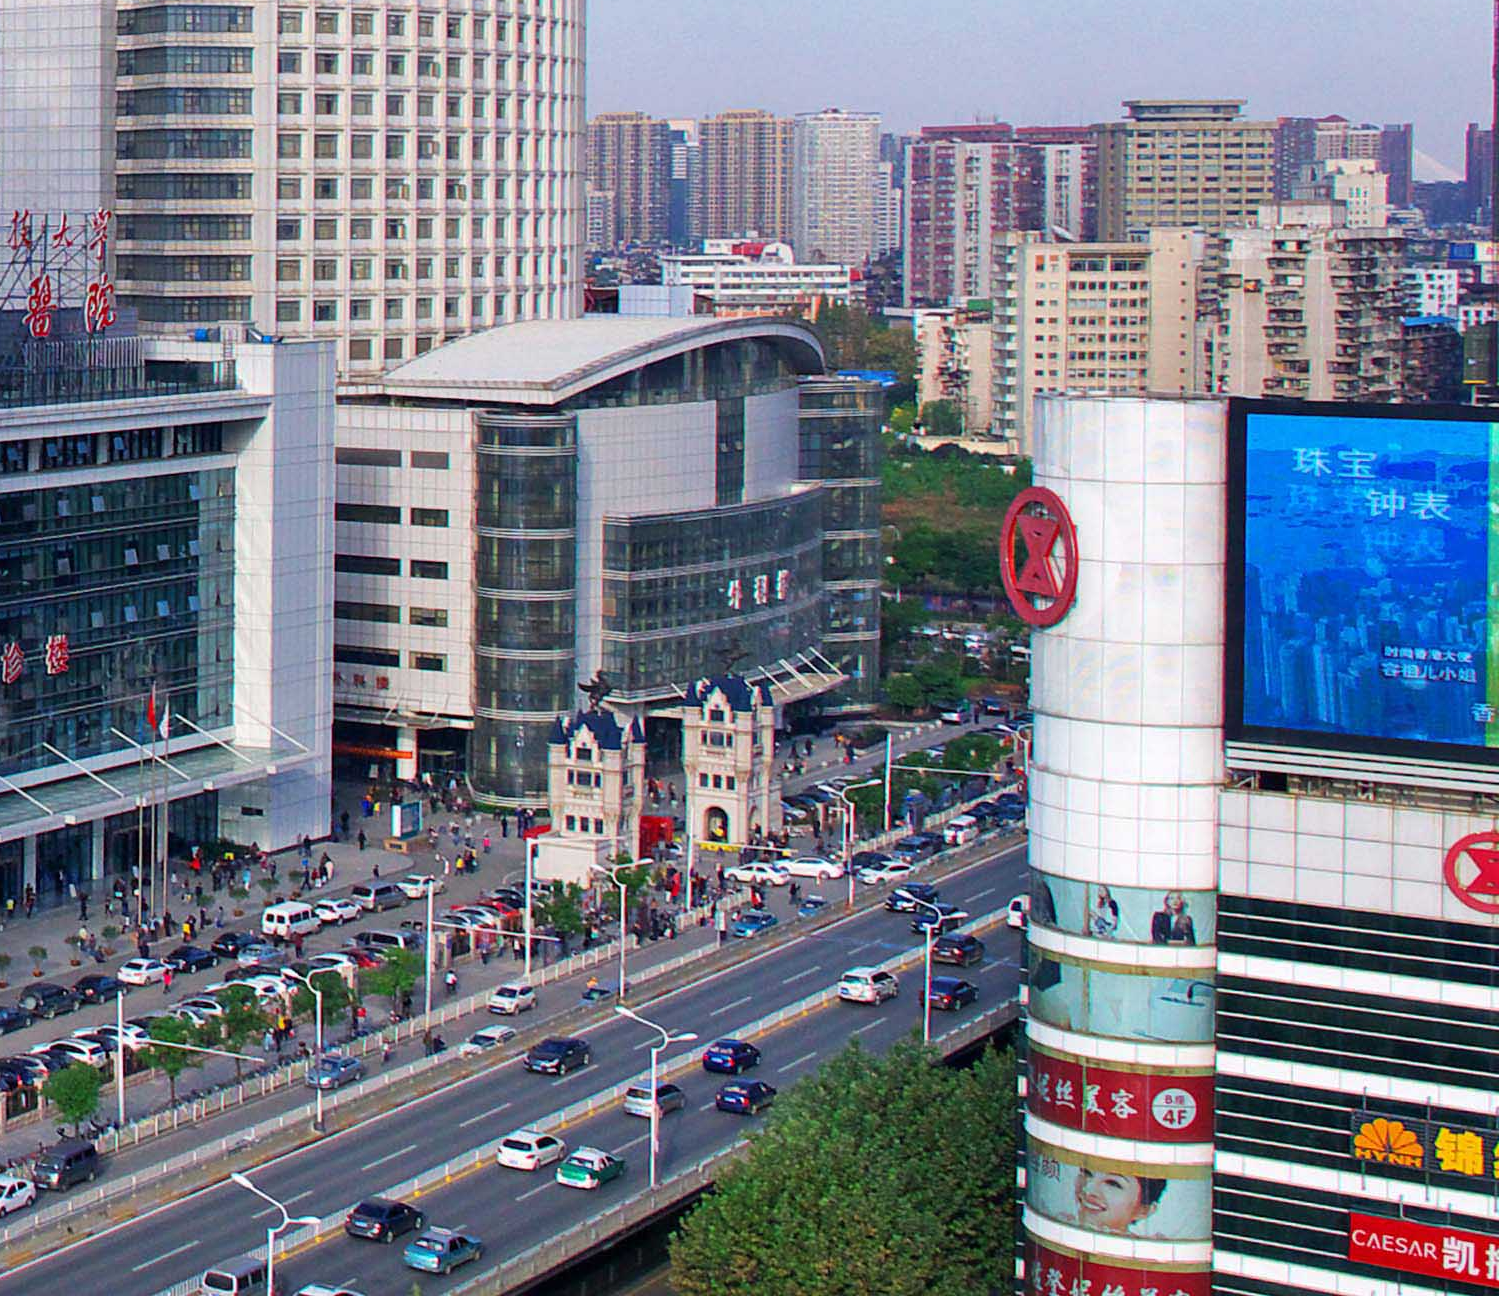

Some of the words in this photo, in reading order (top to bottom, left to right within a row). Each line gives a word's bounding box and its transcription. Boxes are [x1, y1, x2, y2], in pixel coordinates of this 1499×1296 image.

[1291, 447, 1377, 479] 珠宝
[1364, 488, 1452, 521] 钟表
[1163, 1108, 1188, 1126] 4F
[1435, 1127, 1499, 1181] 锦
[1352, 1229, 1438, 1260] CAESAR
